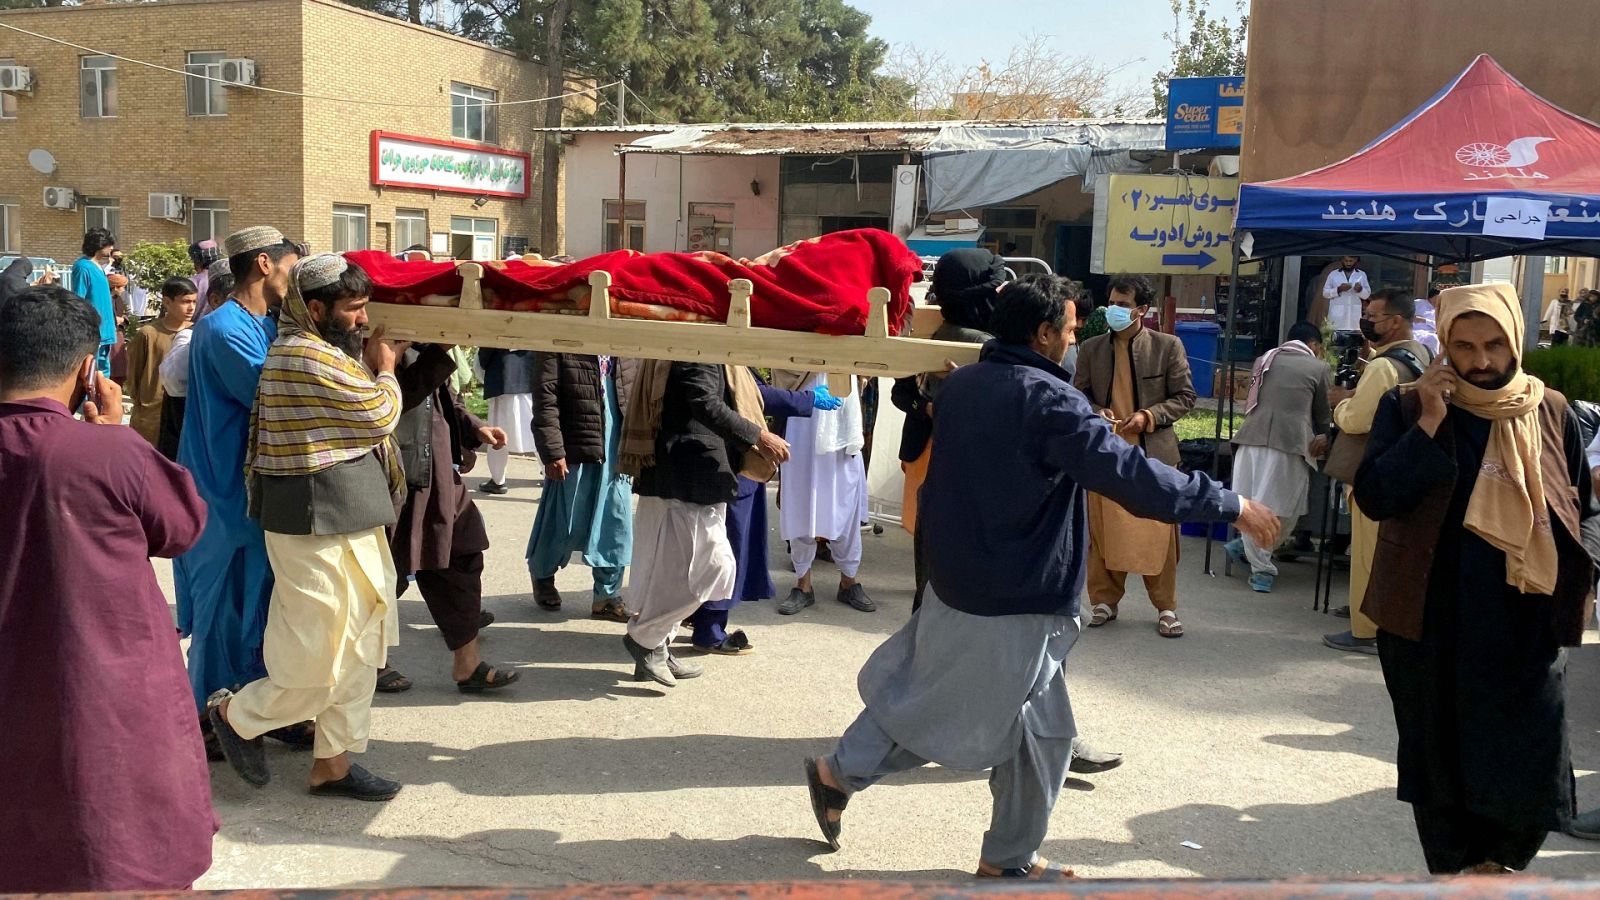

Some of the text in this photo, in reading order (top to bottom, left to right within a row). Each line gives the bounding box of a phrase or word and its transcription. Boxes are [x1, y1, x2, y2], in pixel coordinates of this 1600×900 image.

[1174, 103, 1211, 119] Super
[1322, 200, 1397, 221] هلمند
[1414, 200, 1486, 227] ارک
[1494, 209, 1541, 225] جراحی
[1129, 223, 1230, 248] روش ادویه
